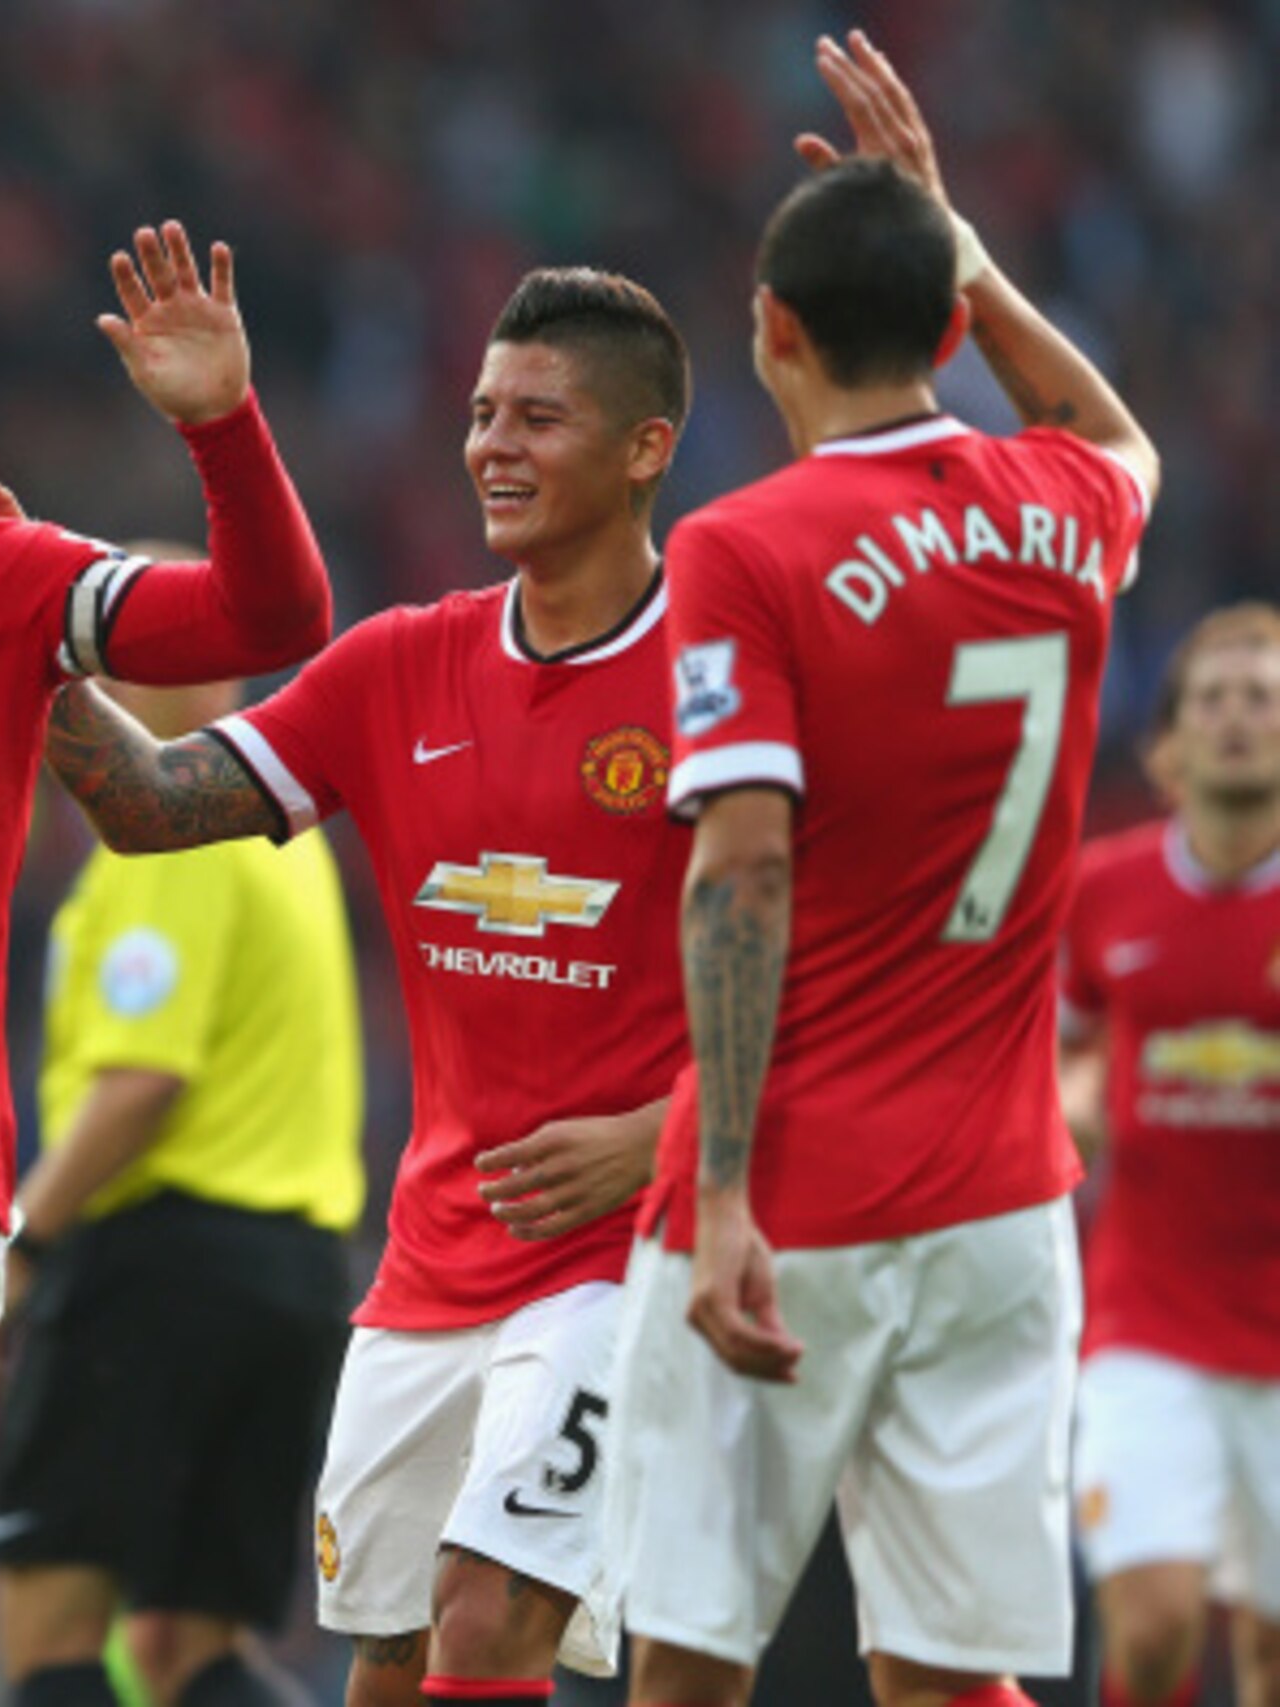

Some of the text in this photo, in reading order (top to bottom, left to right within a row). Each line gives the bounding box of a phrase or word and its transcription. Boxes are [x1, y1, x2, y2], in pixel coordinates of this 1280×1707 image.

[824, 501, 1106, 627] DI MARIA
[942, 630, 1069, 942] 7
[542, 1387, 608, 1494] 5
